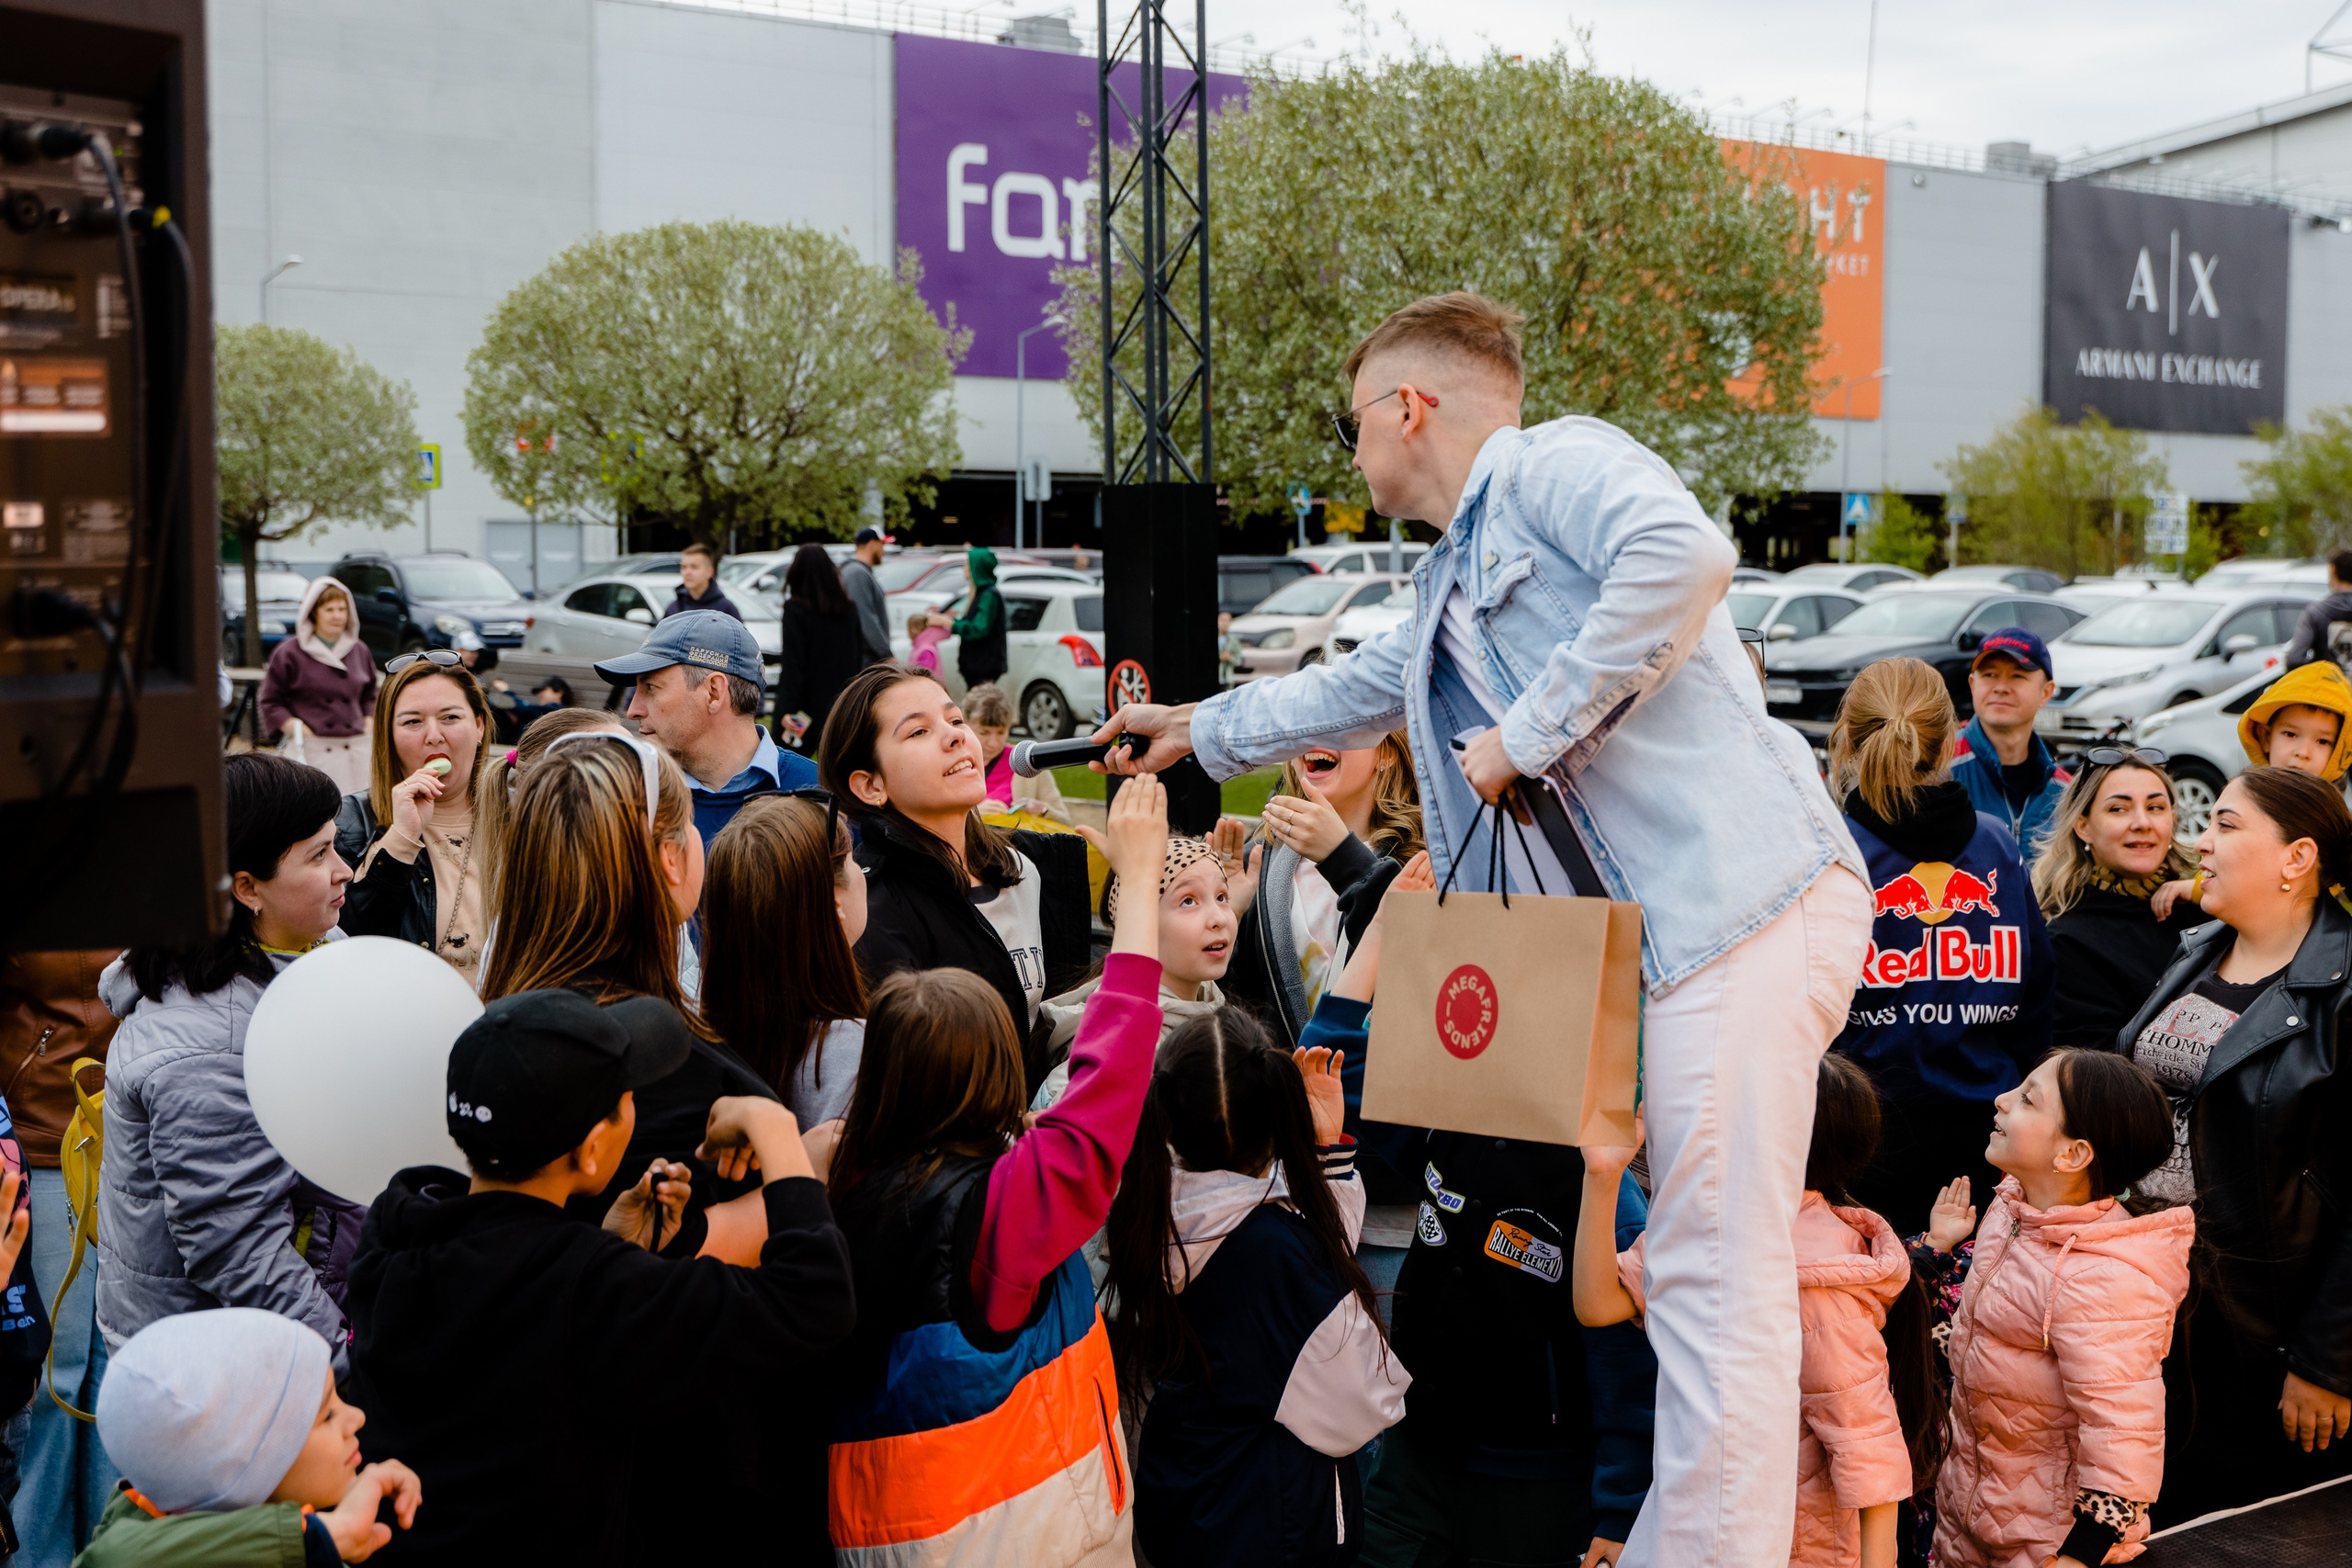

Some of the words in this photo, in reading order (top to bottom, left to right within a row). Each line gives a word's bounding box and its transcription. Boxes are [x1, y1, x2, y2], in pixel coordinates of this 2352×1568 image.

[2075, 346, 2156, 381] ARMANI
[2161, 352, 2263, 389] EXCHANGE
[689, 651, 729, 664] ФЕДЕРАЦИЯ
[690, 646, 729, 660] ПАРУСНАЯ
[1937, 925, 2020, 984] Bull
[1903, 1003, 1953, 1025] YOU
[1959, 1004, 2019, 1025] WINGS
[1488, 1225, 1521, 1260] RALLYE
[1521, 1251, 1561, 1278] ELEMENT
